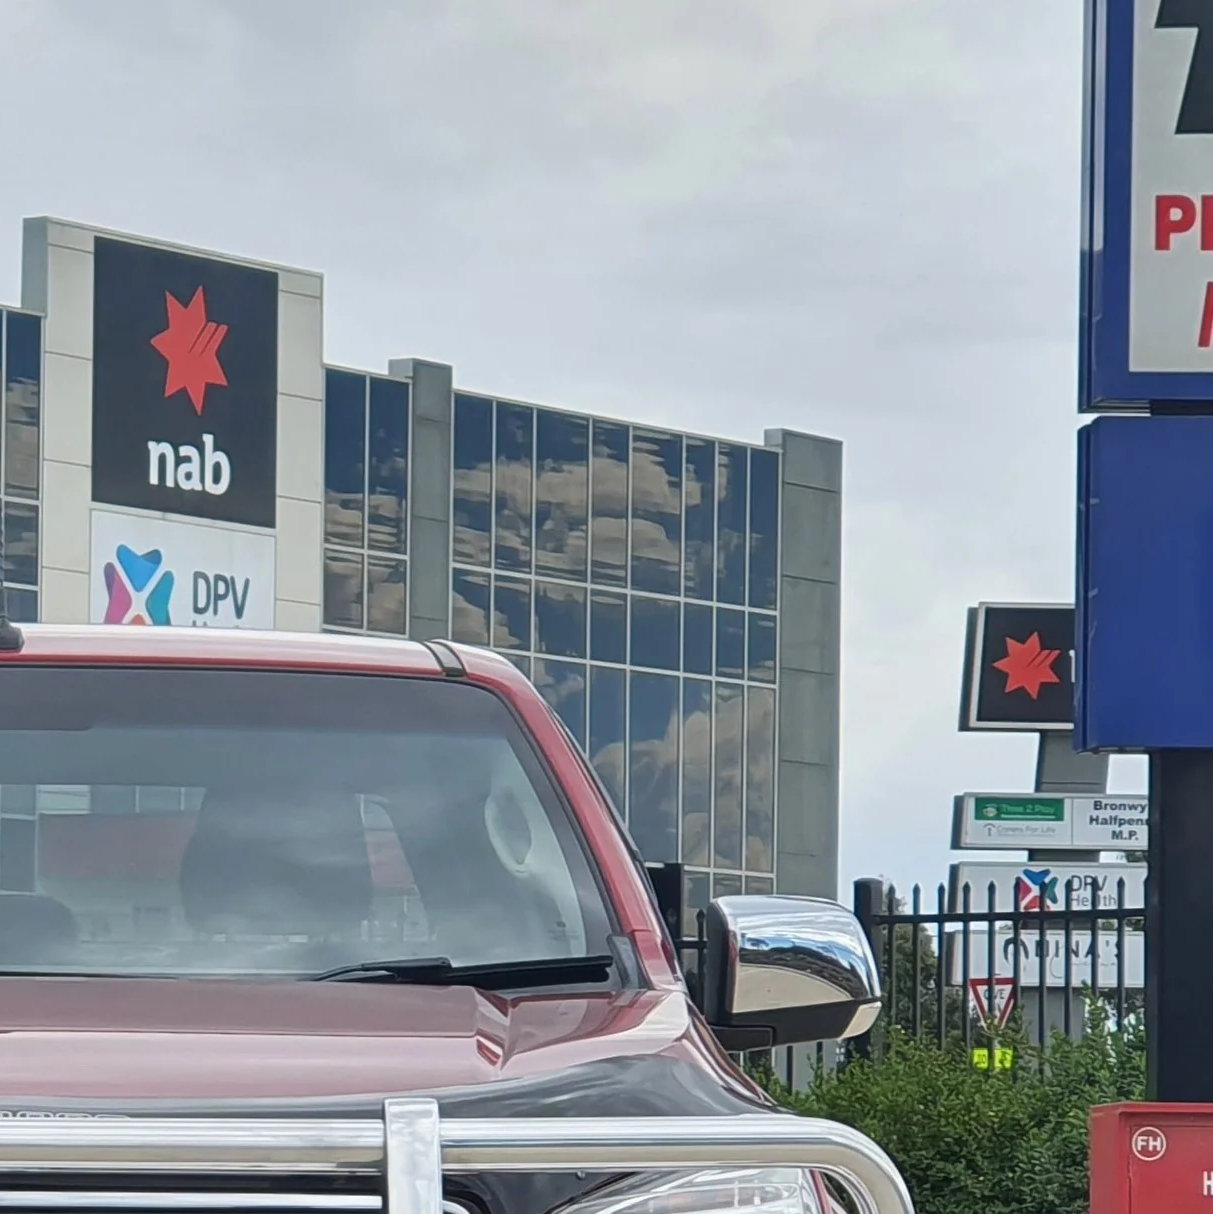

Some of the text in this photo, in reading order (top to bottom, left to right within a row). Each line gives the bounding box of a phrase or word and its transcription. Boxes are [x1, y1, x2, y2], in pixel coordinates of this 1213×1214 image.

[147, 433, 231, 496] nab
[193, 571, 250, 620] DPV
[1093, 800, 1147, 814] Bronwy
[1089, 814, 1148, 828] Halfpen
[1111, 829, 1139, 841] M.P.
[1070, 893, 1118, 907] Helth
[1137, 1136, 1162, 1152] FH
